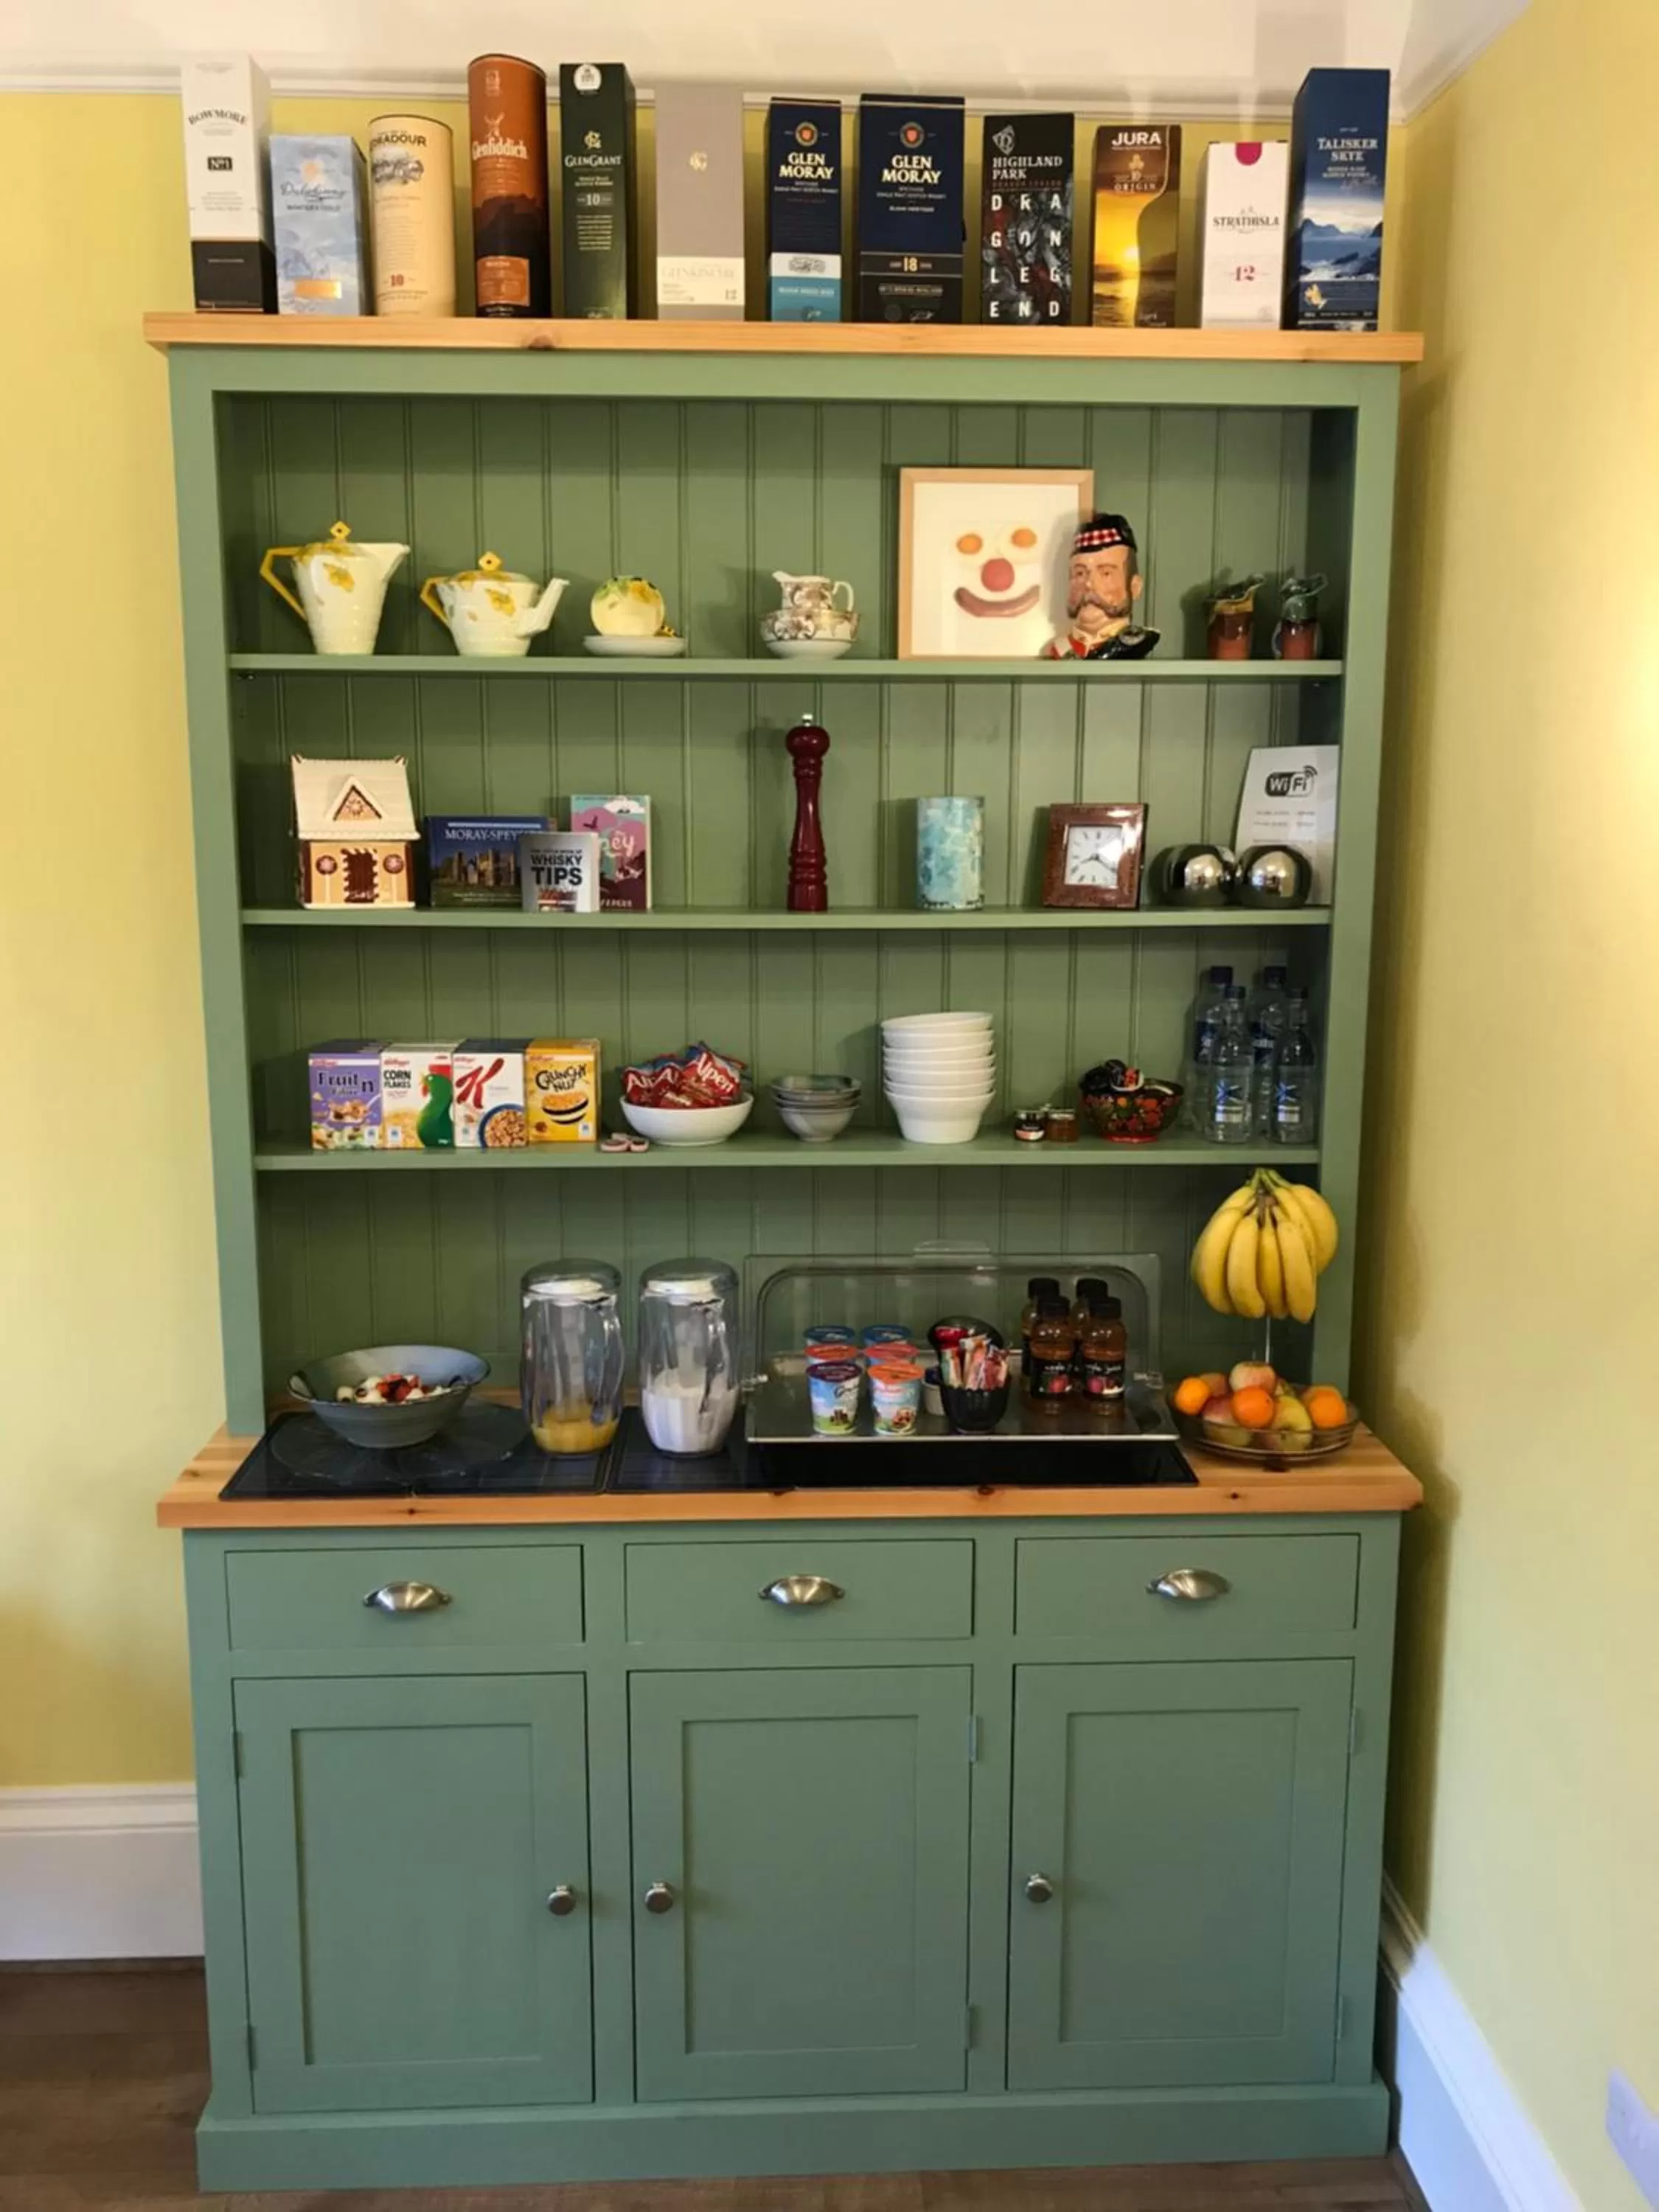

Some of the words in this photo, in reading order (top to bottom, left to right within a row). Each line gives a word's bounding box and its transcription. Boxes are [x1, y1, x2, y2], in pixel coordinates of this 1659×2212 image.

[1111, 131, 1162, 146] JURA
[1318, 137, 1378, 150] TALISKER
[787, 152, 826, 166] GLEN
[891, 154, 932, 169] GLEN
[992, 156, 1062, 168] HIGHLAND
[1331, 150, 1363, 161] SKYE
[779, 164, 835, 179] MORAY
[882, 168, 942, 184] MORAY
[992, 167, 1027, 180] PARK
[586, 192, 600, 206] 10
[903, 256, 918, 272] 18
[391, 274, 404, 287] 10
[1235, 265, 1256, 282] 12
[530, 855, 582, 866] WHISKY
[531, 866, 582, 886] TIPS
[383, 1070, 411, 1080] CORN
